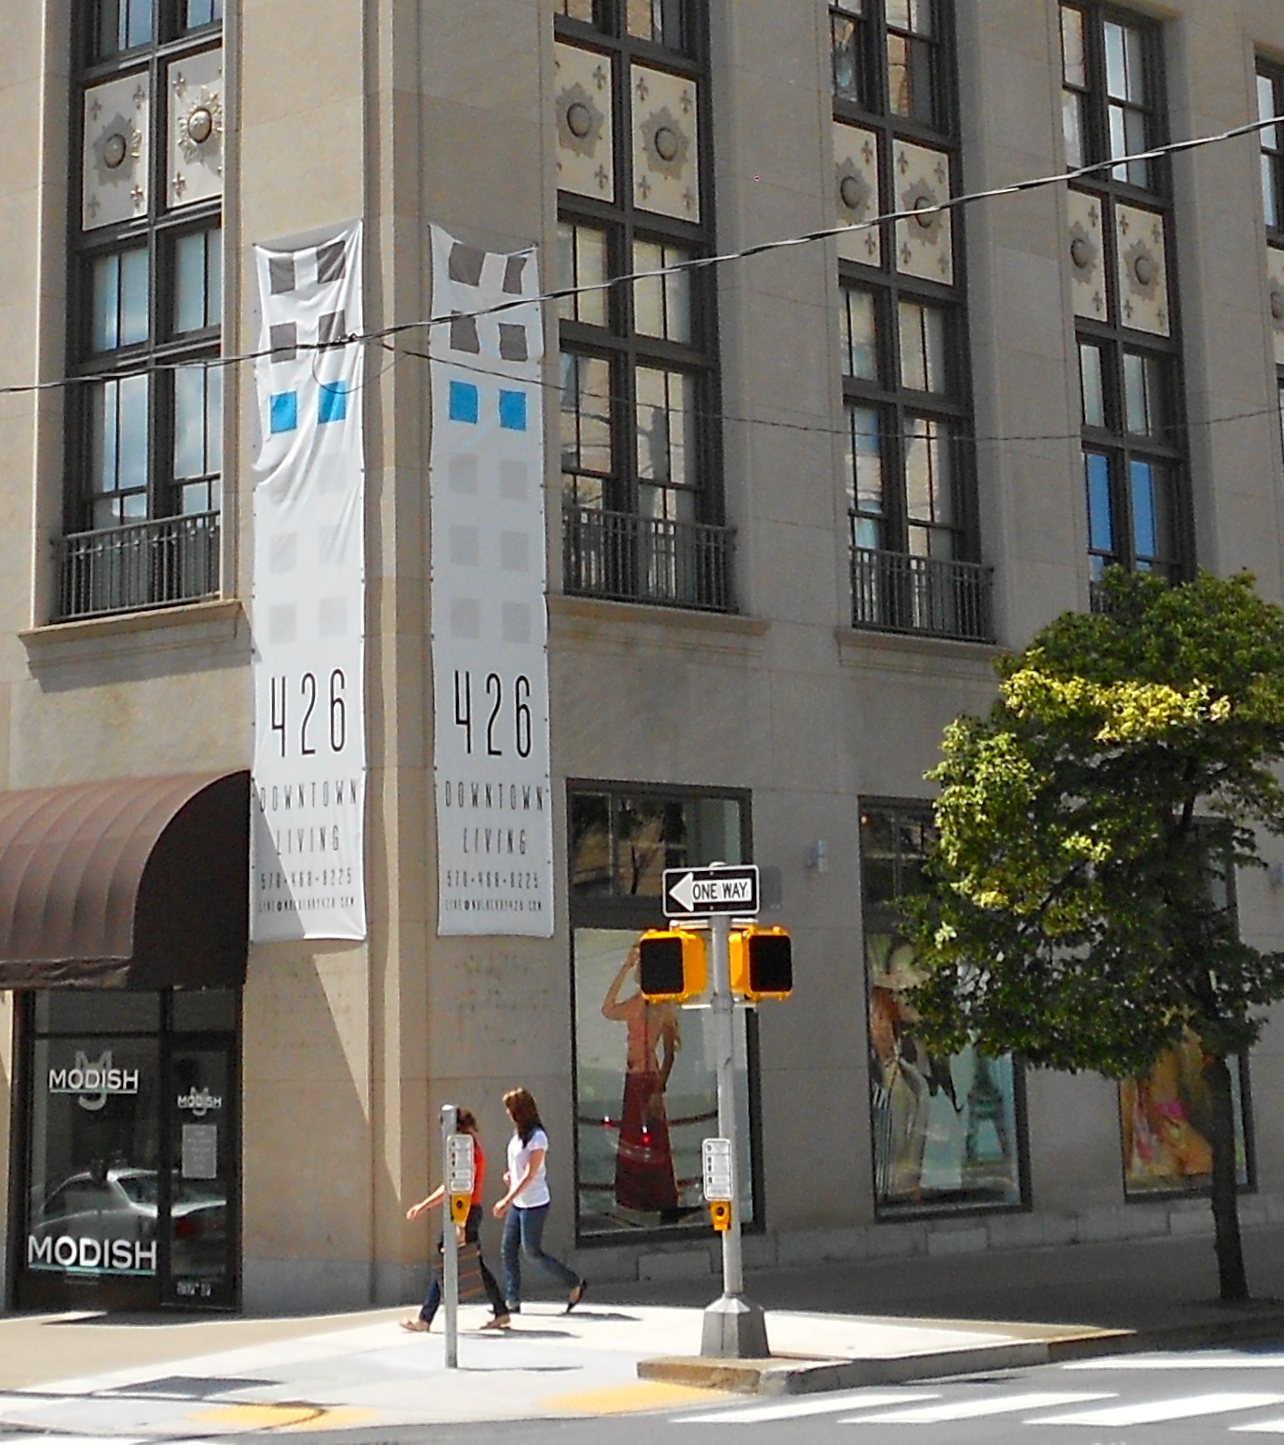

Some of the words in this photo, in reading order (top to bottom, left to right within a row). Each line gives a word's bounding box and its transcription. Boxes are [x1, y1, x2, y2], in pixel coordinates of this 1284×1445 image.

[271, 668, 346, 758] 426
[454, 670, 532, 758] 426
[260, 778, 357, 813] DOWNTOWN
[445, 780, 544, 811] DOWNTOWN
[275, 824, 340, 856] LIVING
[463, 827, 527, 855] LIVING
[692, 883, 718, 900] ONE
[721, 881, 748, 899] WAY
[48, 1068, 139, 1090] MODISH
[176, 1095, 222, 1108] MODISH
[27, 1235, 157, 1270] MODISH
